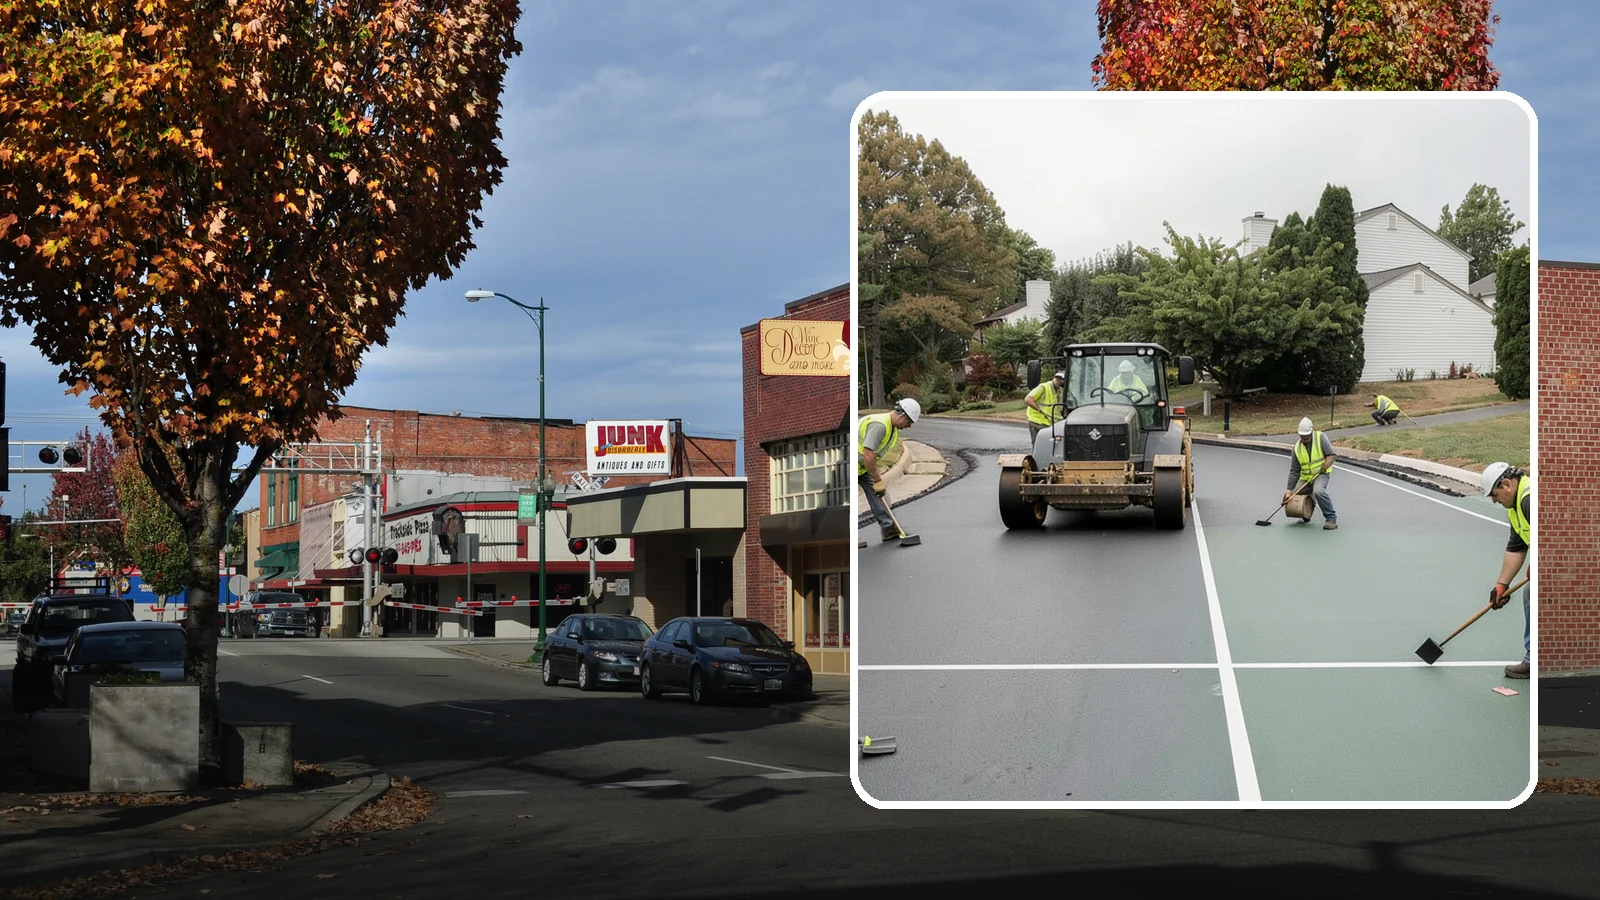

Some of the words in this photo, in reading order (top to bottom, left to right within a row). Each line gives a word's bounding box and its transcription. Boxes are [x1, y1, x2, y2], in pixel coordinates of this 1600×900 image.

[596, 425, 665, 457] JUNK
[608, 446, 645, 454] DISORDERLY
[597, 461, 628, 470] ANTIQUES
[631, 461, 644, 470] AND
[646, 460, 665, 470] GIFTS
[573, 473, 588, 491] RAIL
[414, 519, 429, 534] Pizza
